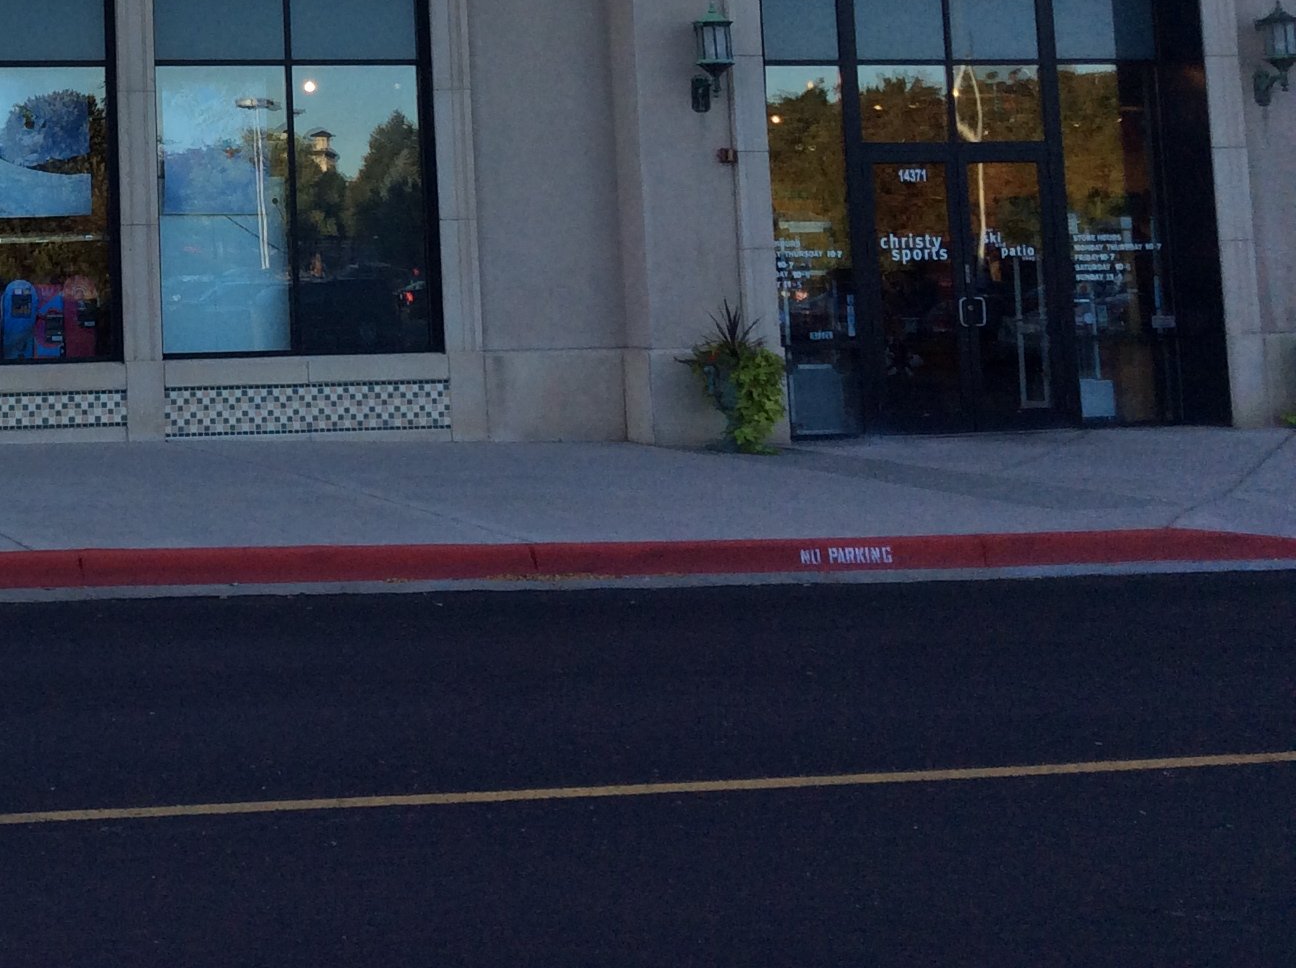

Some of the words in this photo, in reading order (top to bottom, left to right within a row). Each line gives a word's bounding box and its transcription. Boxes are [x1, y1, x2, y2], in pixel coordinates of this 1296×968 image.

[898, 168, 927, 183] 14371
[880, 233, 942, 250] christy
[891, 248, 948, 265] sports
[1001, 244, 1035, 259] patio
[828, 546, 893, 564] PARKING
